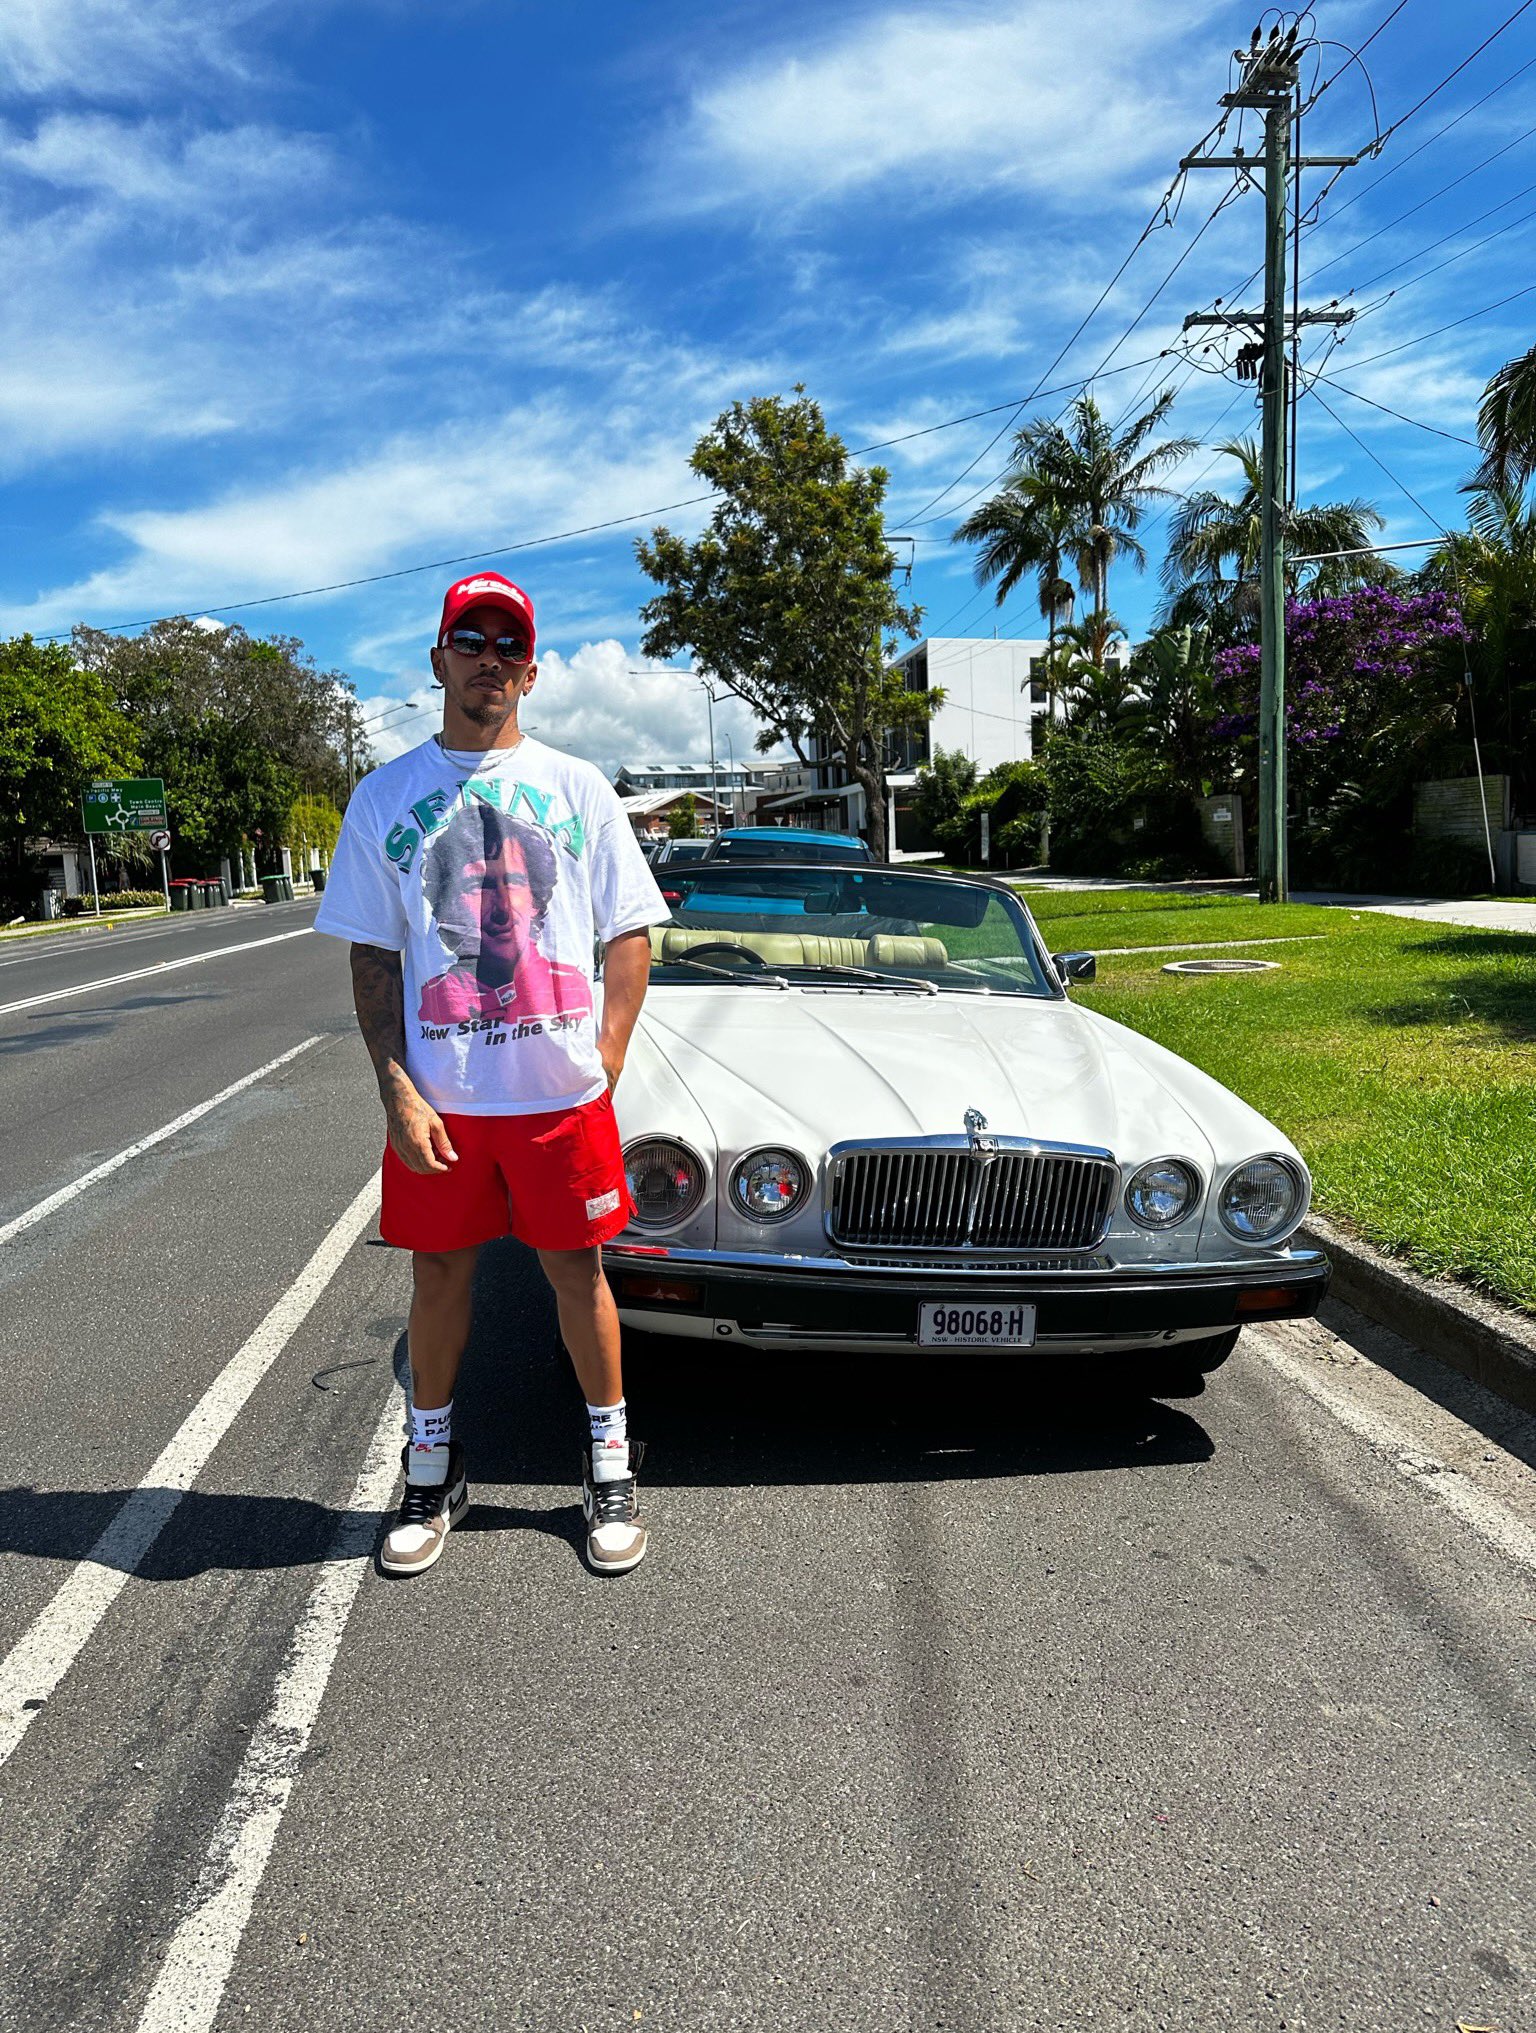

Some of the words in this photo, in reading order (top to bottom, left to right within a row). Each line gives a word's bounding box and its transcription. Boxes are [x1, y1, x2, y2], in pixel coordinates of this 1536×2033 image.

[384, 777, 586, 875] SENNA
[420, 1025, 451, 1041] New
[456, 1016, 504, 1036] Star
[485, 1031, 507, 1046] in
[511, 1022, 543, 1041] the
[549, 1014, 582, 1032] Sky
